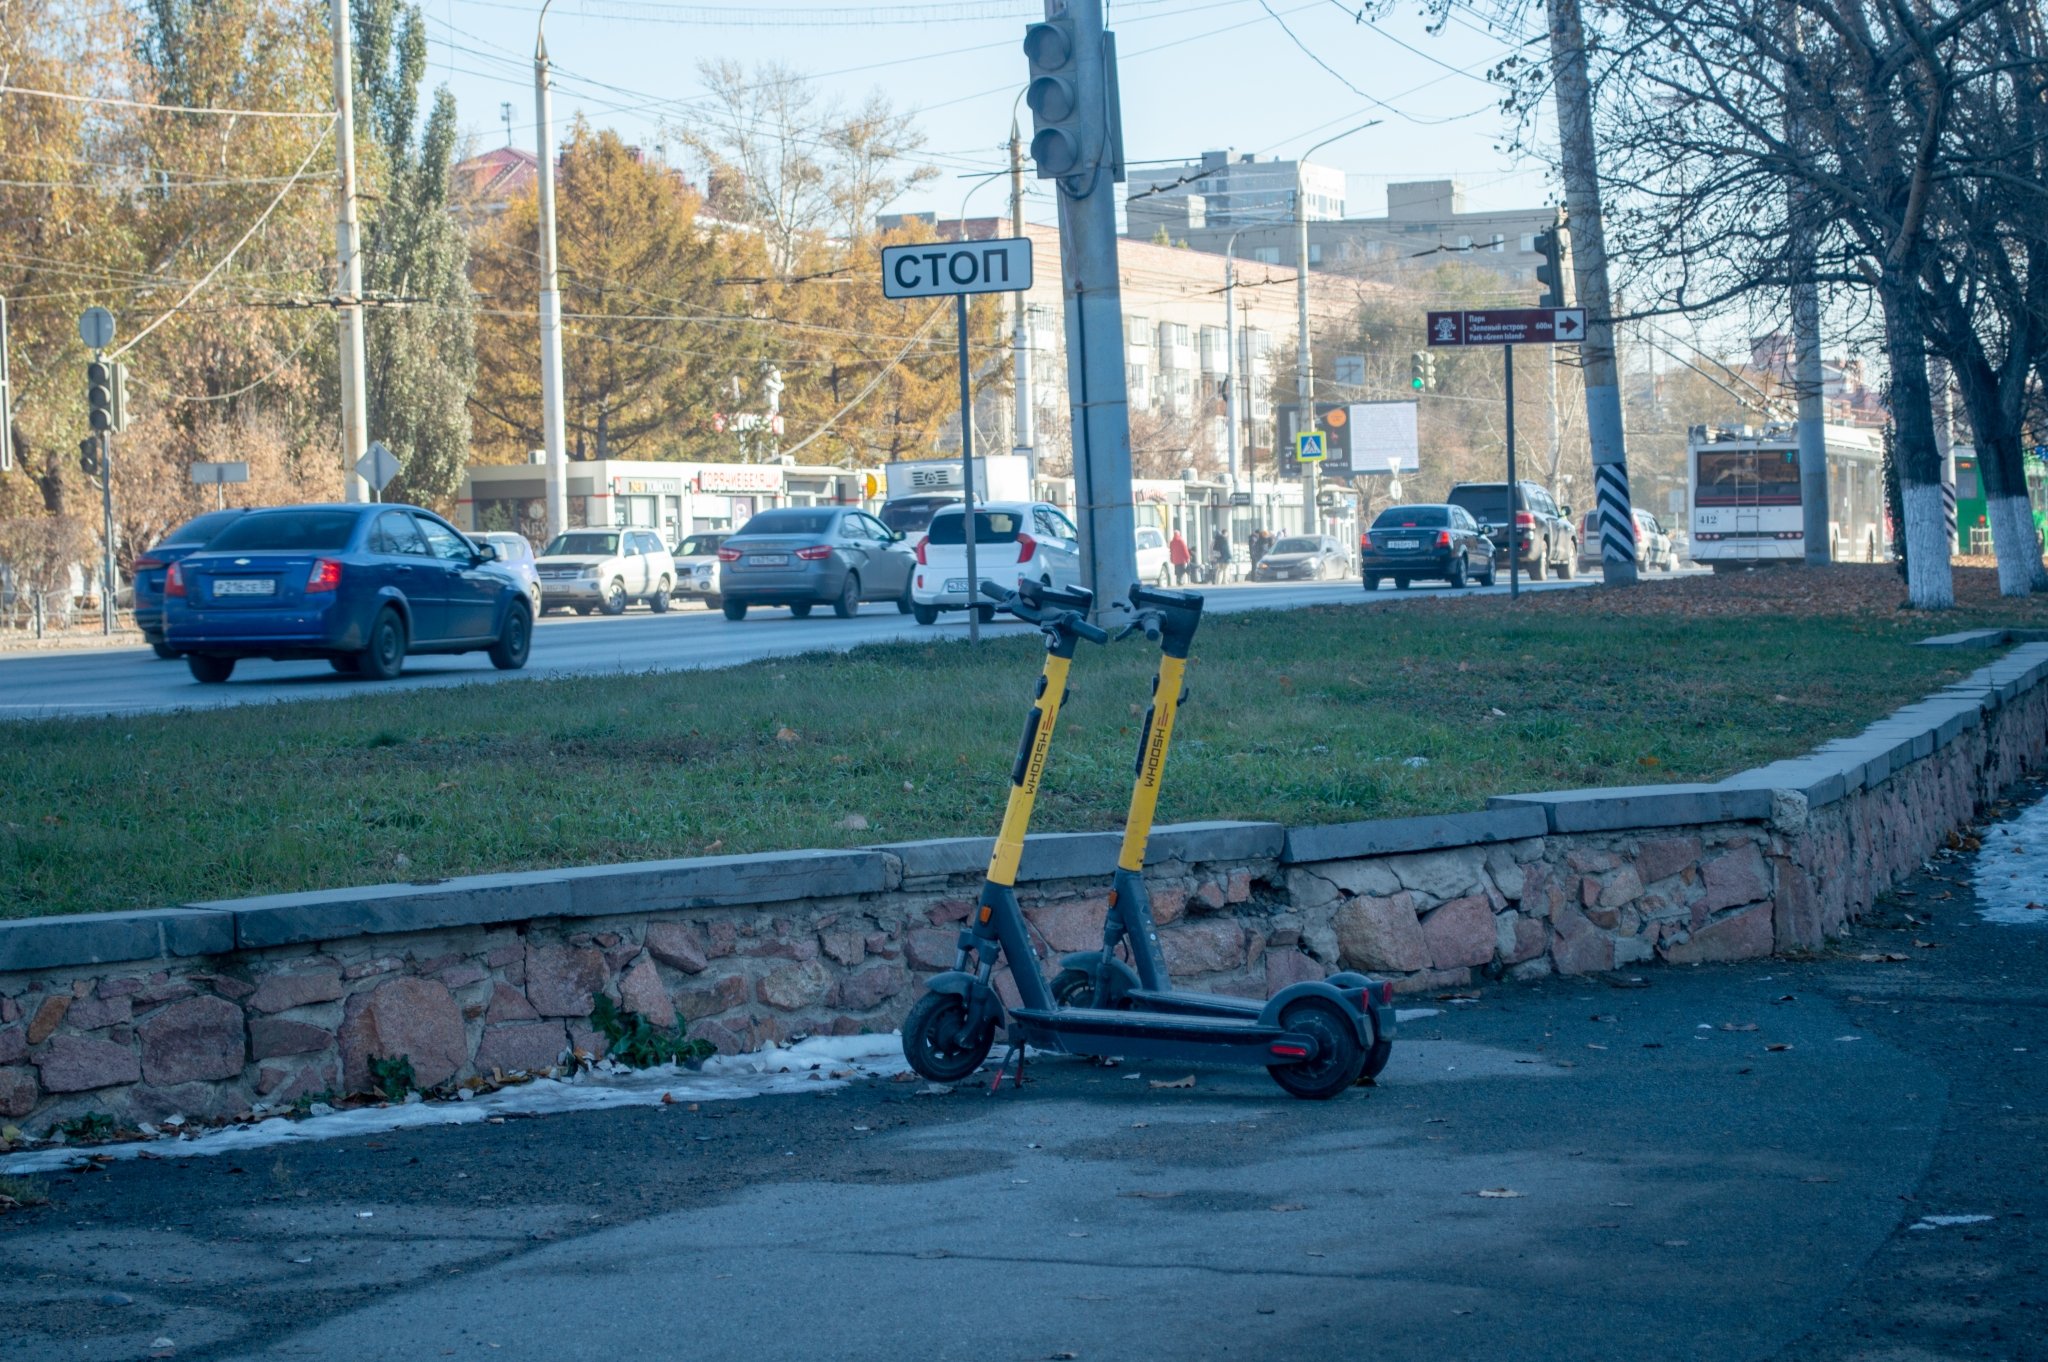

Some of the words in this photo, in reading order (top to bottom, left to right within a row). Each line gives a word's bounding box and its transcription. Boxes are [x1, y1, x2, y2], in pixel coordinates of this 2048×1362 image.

[894, 248, 1009, 289] СТОП
[1468, 314, 1486, 324] Парк
[1535, 321, 1553, 330] 600м
[1469, 333, 1482, 341] Park
[1785, 452, 1793, 464] 7
[743, 472, 780, 489] БЕЛЯШИ
[1699, 515, 1718, 525] 412
[1025, 732, 1049, 795] WHOOSH
[1144, 728, 1165, 787] WHOOSH
